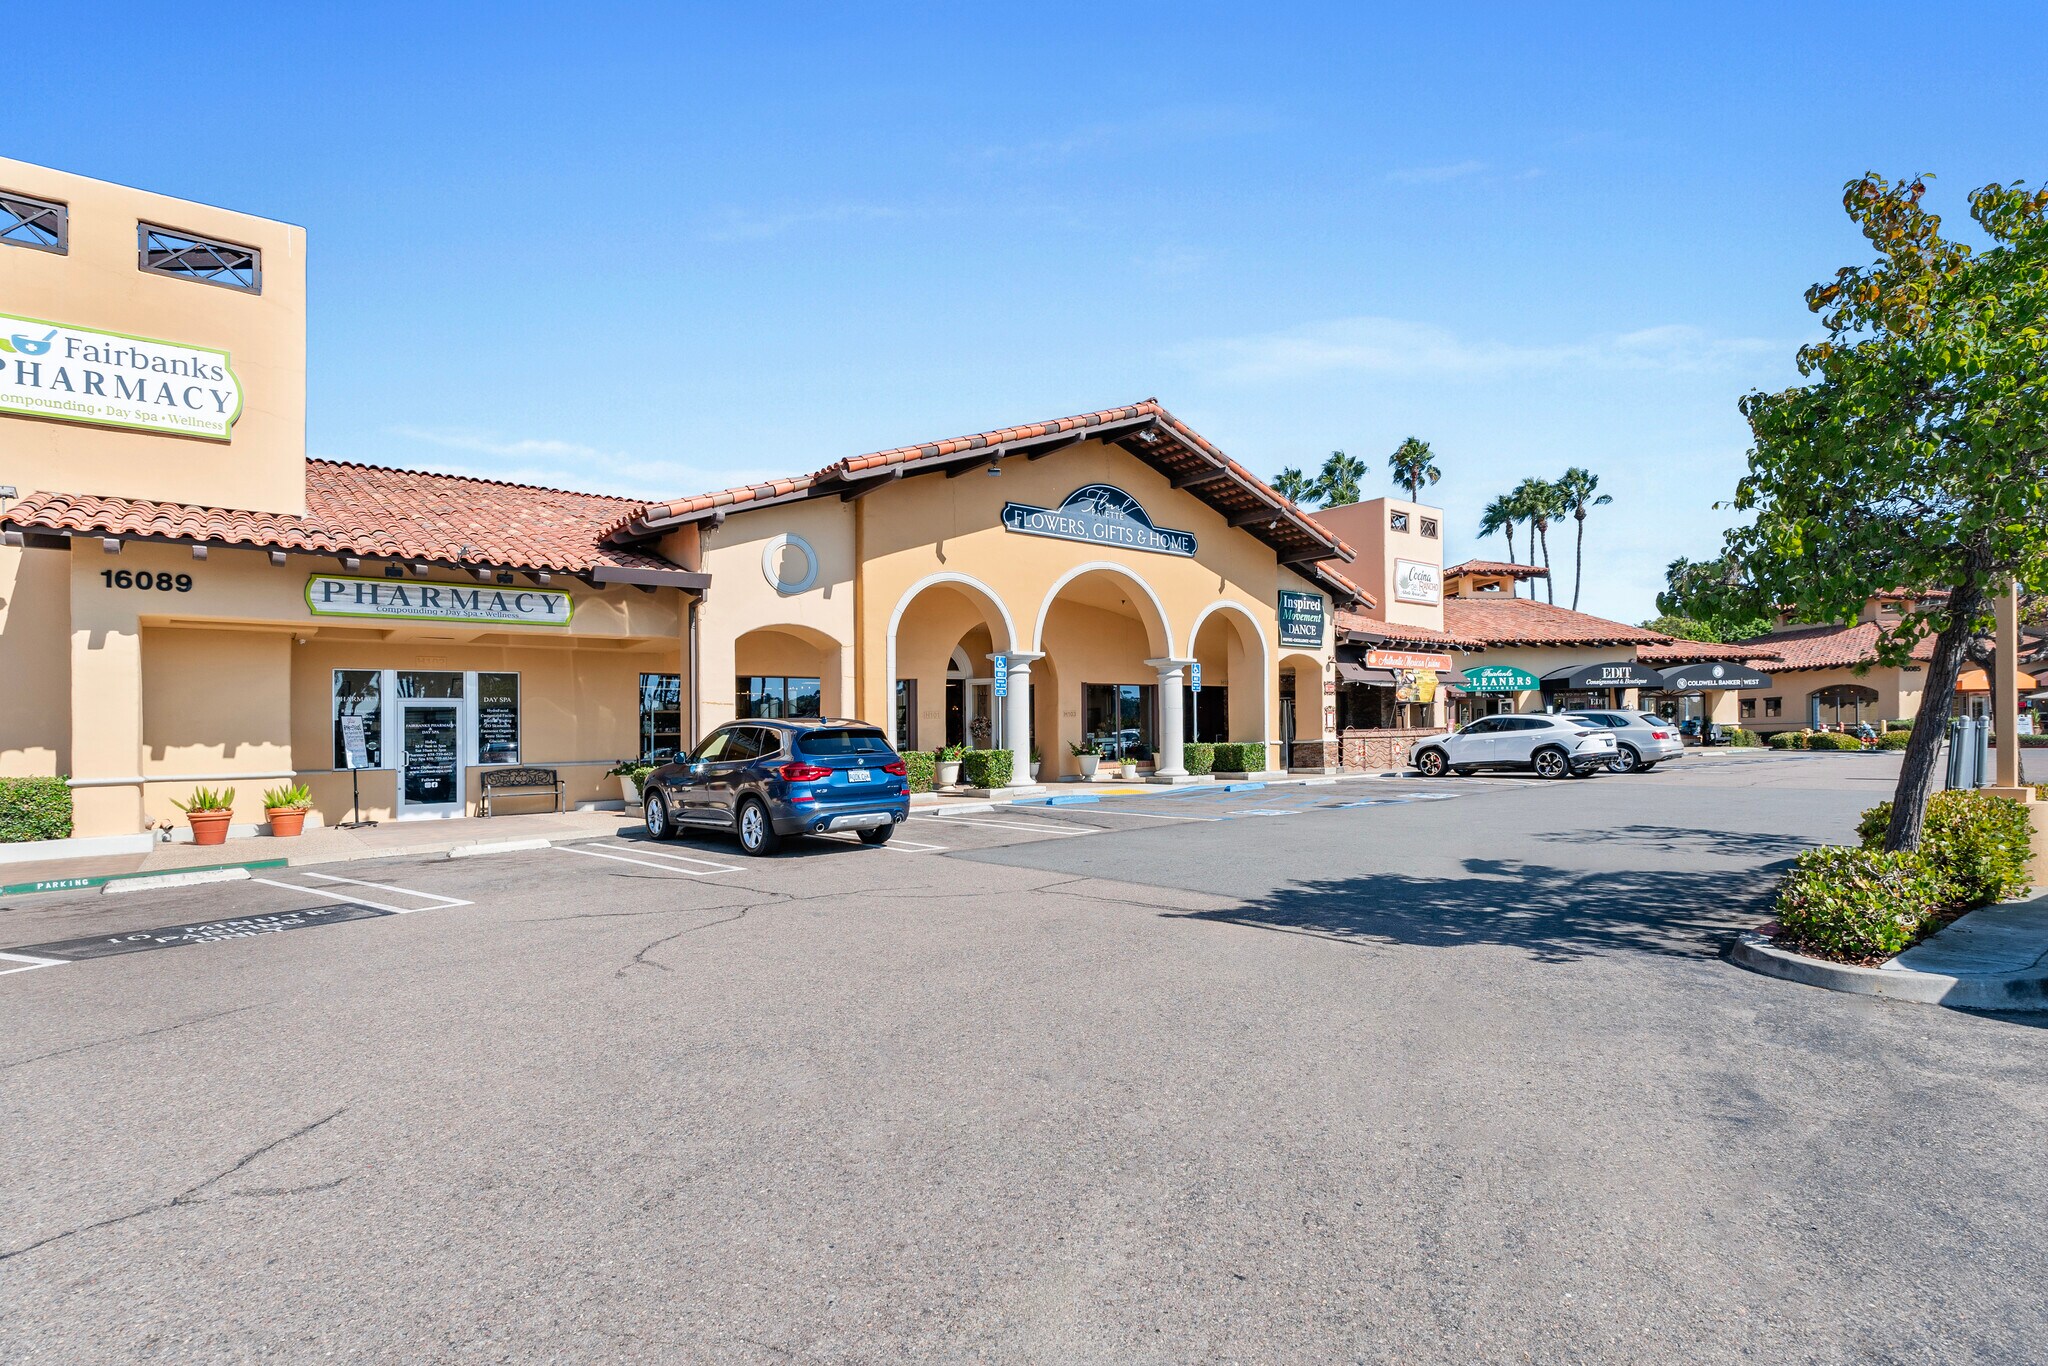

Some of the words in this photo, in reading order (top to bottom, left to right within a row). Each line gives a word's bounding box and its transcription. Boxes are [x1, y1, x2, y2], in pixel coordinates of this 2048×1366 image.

[64, 336, 224, 382] Fairbanks
[0, 392, 95, 416] ompounding
[105, 404, 131, 420] Day
[134, 408, 158, 422] Spa
[168, 413, 223, 431] Wellness
[1014, 510, 1089, 539] FLOWERS,
[1094, 522, 1133, 543] GIFTS
[1138, 531, 1147, 543] &
[1150, 531, 1190, 551] HOME
[100, 569, 193, 593] 16089
[1408, 566, 1432, 582] Cocina
[321, 581, 563, 614] PHARMACY
[1283, 595, 1321, 612] Inspired
[376, 605, 438, 616] Compounding
[485, 611, 520, 619] Wellness
[1282, 609, 1322, 622] Movement
[1288, 623, 1317, 636] DANCE
[1379, 654, 1403, 666] Authentic
[1404, 655, 1424, 667] Mexican
[1602, 667, 1632, 679] EDIT
[36, 878, 89, 890] PARKING
[185, 908, 332, 933] MINUTE
[154, 918, 306, 944] PARKING
[194, 926, 284, 943] ONLY
